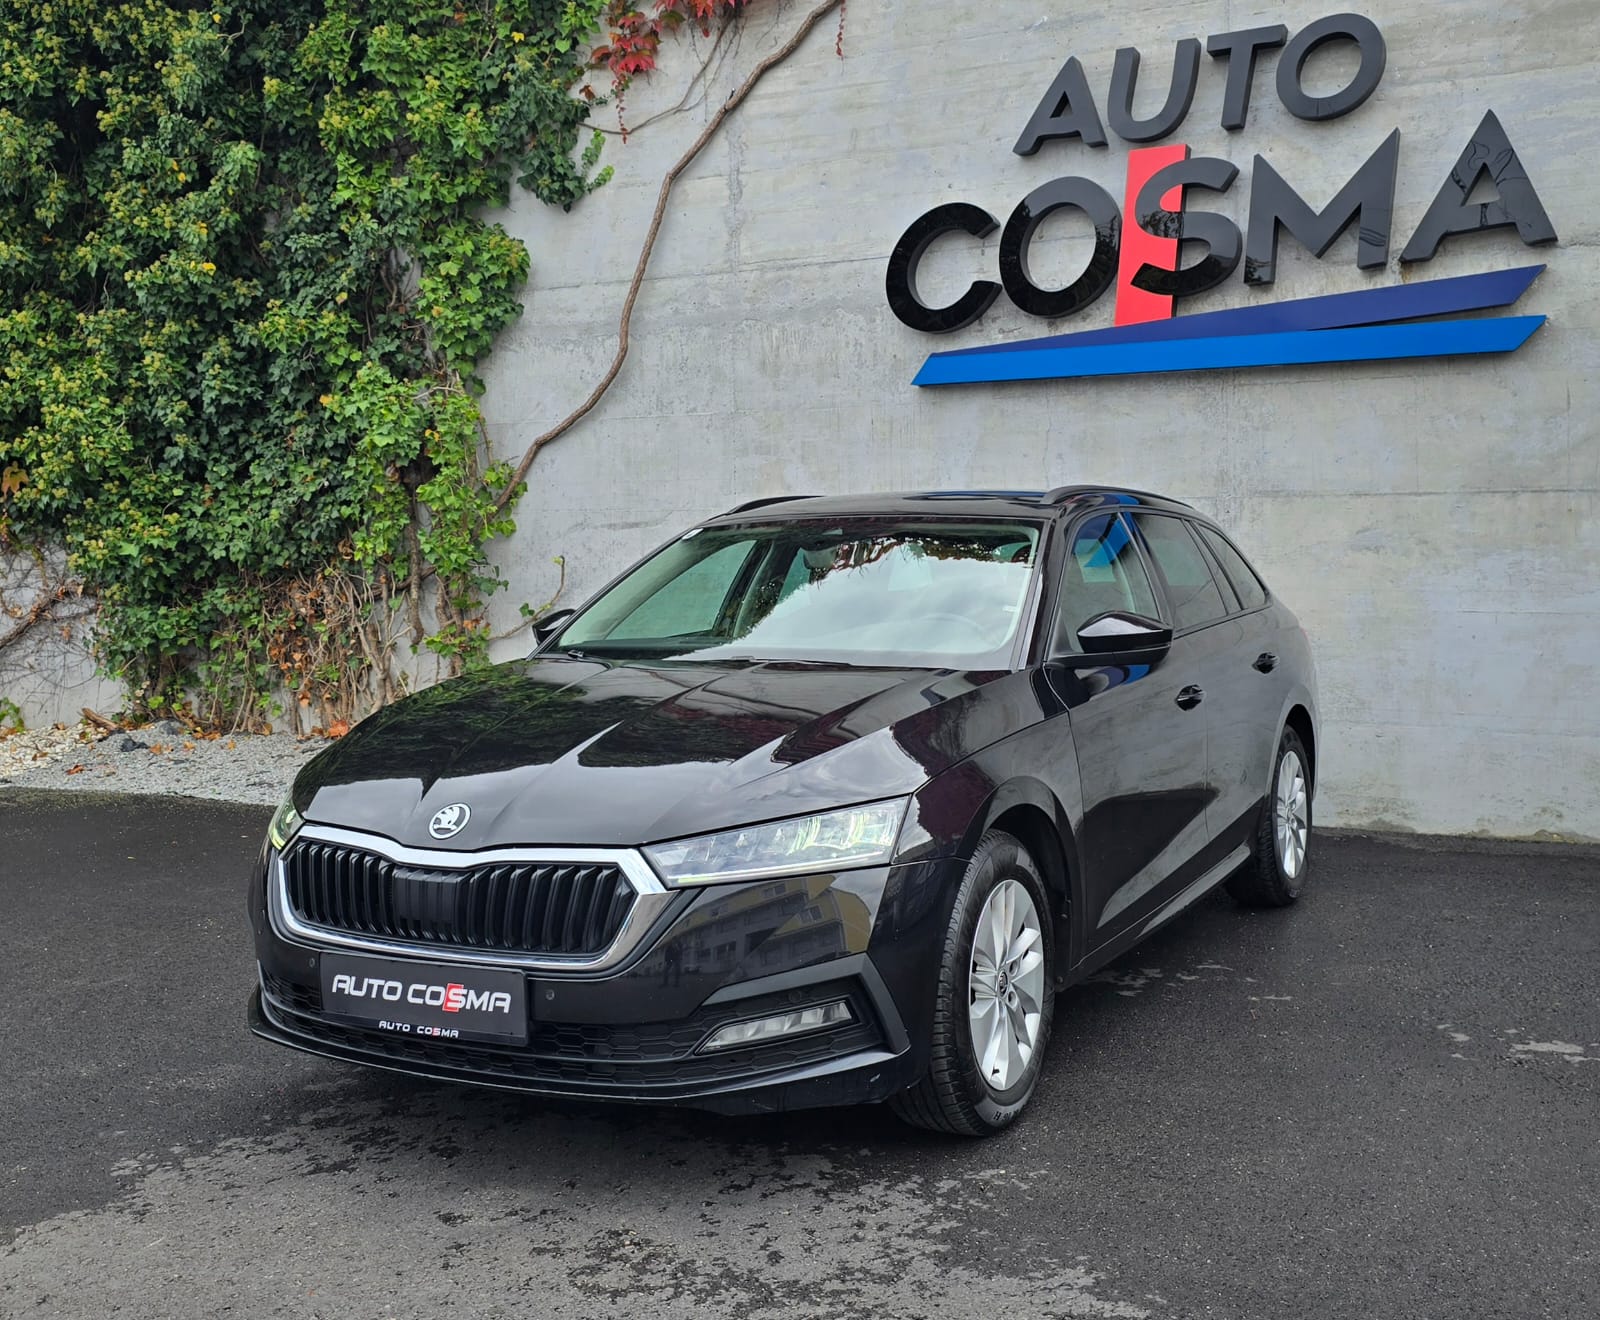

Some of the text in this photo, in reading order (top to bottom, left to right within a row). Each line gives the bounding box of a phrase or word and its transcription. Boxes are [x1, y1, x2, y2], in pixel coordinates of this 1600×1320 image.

[1012, 12, 1387, 157] AUTO
[885, 108, 1558, 335] COSMA
[331, 974, 512, 1014] AUTO COSMA
[378, 1020, 460, 1038] AUTO COSMA
